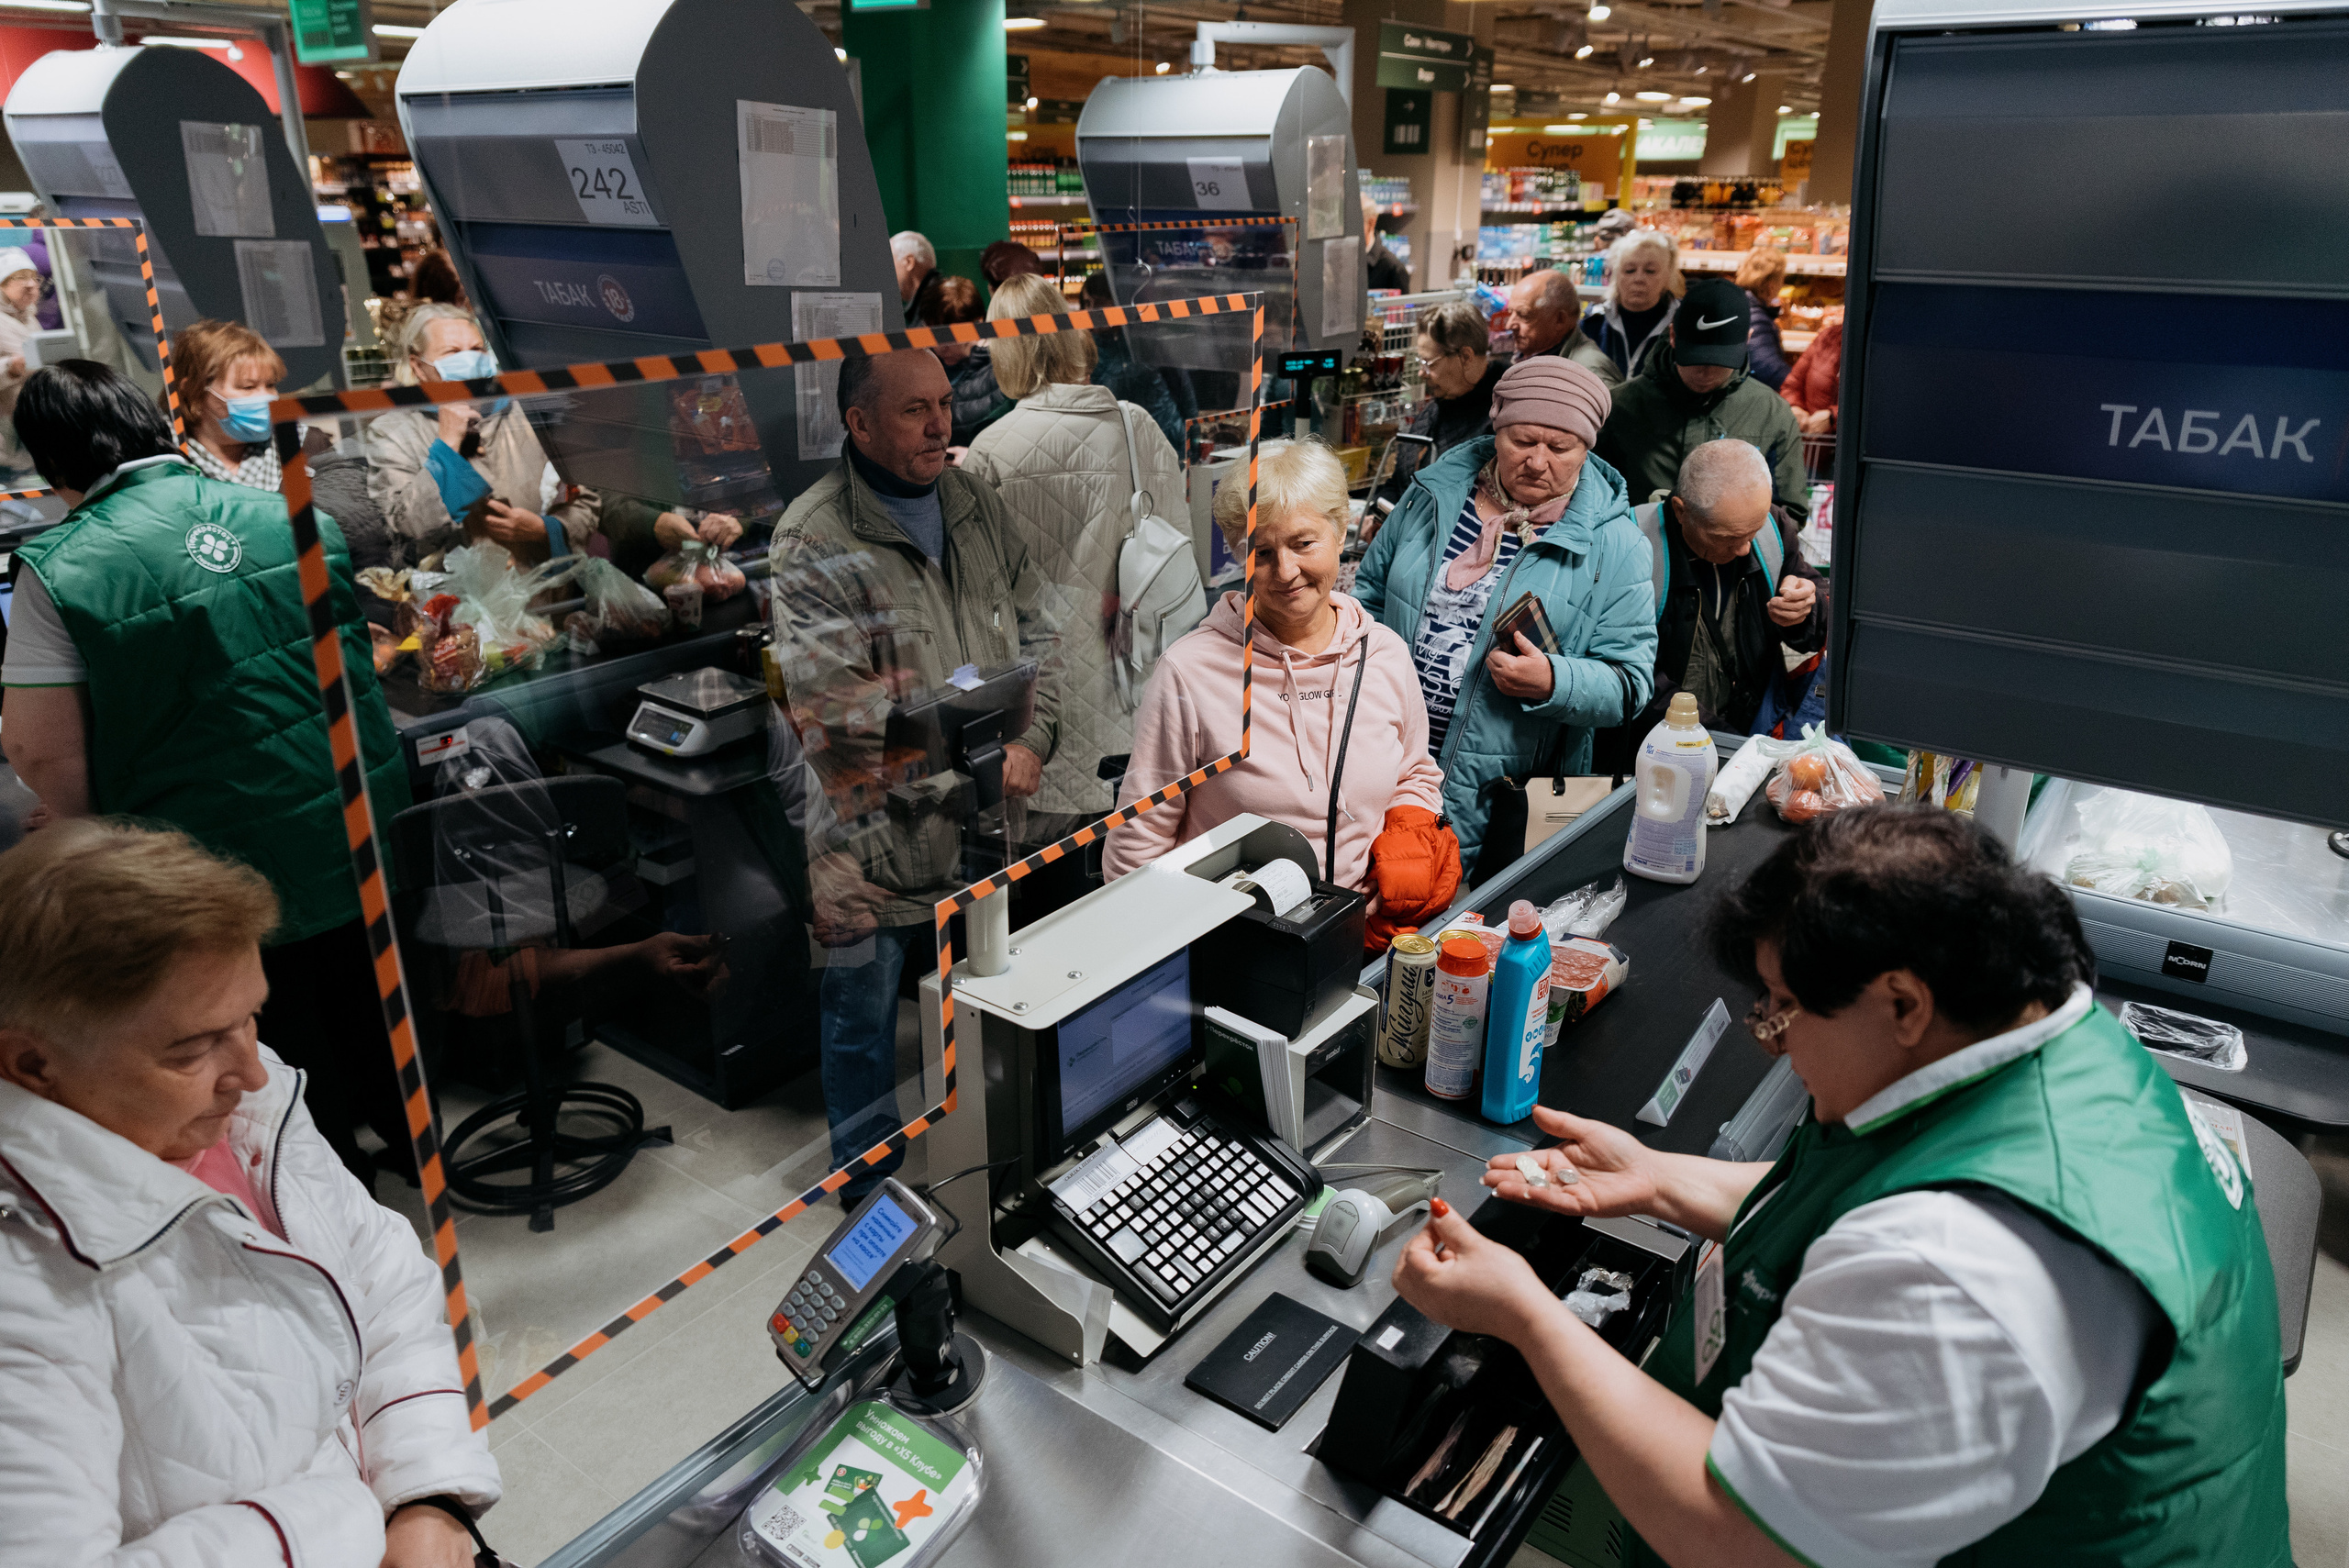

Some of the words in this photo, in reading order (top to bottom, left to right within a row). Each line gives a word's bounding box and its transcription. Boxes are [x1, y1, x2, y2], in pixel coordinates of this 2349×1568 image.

[1527, 139, 1584, 161] Супер
[1637, 134, 1706, 158] АКАЛЕ
[572, 167, 635, 199] 242
[1196, 181, 1220, 196] 36
[624, 201, 651, 215] ASTI
[533, 280, 596, 307] ТАБАК
[2100, 403, 2321, 462] ТАБАК
[1298, 690, 1322, 701] GLOW
[1447, 994, 1455, 1005] 5
[1386, 964, 1425, 1064] Жигули
[870, 1215, 896, 1240] наличные
[877, 1207, 903, 1233] Снимайте
[852, 1236, 860, 1245] на
[858, 1229, 869, 1240] при
[868, 1239, 886, 1258] оплате
[867, 1225, 885, 1242] карты
[1243, 1330, 1277, 1362] CAUTION!
[1261, 1393, 1271, 1404] NOT
[1269, 1381, 1283, 1395] PLACE
[1280, 1367, 1296, 1383] CREDIT
[1294, 1354, 1308, 1369] CARDS
[1311, 1340, 1321, 1351] THIS
[1319, 1325, 1337, 1342] SURFACE
[864, 1408, 910, 1444] Умножаем
[855, 1420, 888, 1445] выгоду
[885, 1440, 894, 1449] в
[908, 1454, 942, 1480] Клубе»
